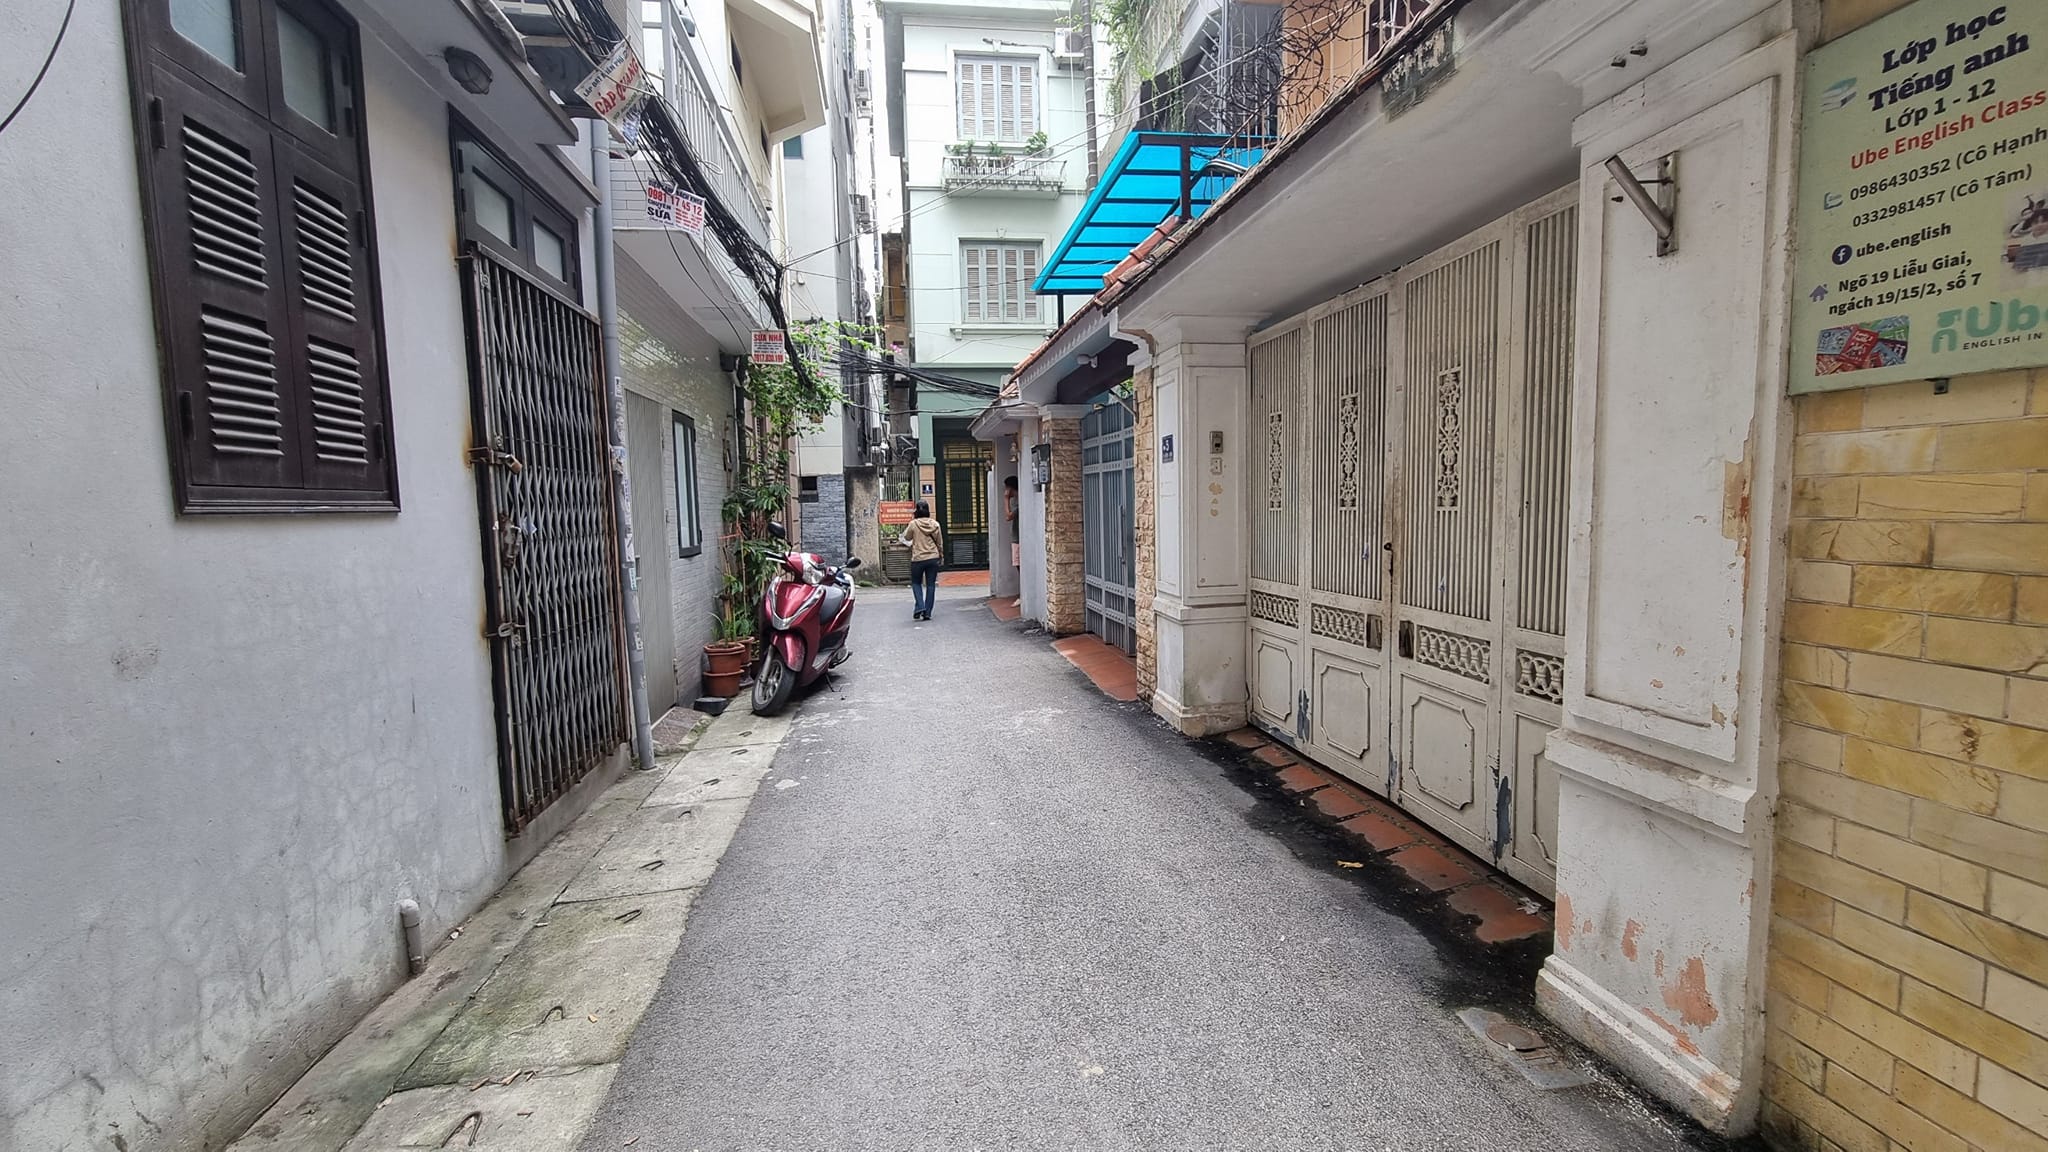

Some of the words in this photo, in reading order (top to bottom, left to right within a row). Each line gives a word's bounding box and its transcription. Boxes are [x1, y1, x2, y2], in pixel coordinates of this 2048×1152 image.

[1882, 40, 1936, 73] Lớp
[1945, 6, 2006, 46] học
[1868, 64, 1955, 111] Tiếng
[1963, 32, 2029, 74] anh
[1851, 147, 1889, 169] Ube
[1895, 114, 1975, 149] English
[1981, 90, 2047, 128] Class
[1885, 107, 1928, 133] Lớp
[1934, 98, 1946, 115] 1
[1967, 78, 1996, 103] 12
[1850, 159, 1951, 200] 0986430352
[1956, 145, 1987, 170] (Cô
[1853, 190, 1946, 227] 0332981457
[1951, 180, 1979, 202] (Cô
[1984, 163, 2032, 189] Tâm)
[671, 195, 680, 207] 17
[693, 204, 702, 217] 12
[1856, 223, 1951, 257] ube.english
[1829, 296, 1873, 315] ngách
[1876, 282, 1942, 306] 19/15/2,
[1946, 269, 1967, 291] số
[1971, 272, 1981, 285] 7
[1839, 274, 1867, 292] Ngõ
[1871, 271, 1889, 285] 19
[1893, 258, 1927, 280] Liễu
[1932, 251, 1972, 270] Giai,
[1963, 335, 2020, 350] ENGLISH
[2028, 332, 2042, 341] IN
[1966, 298, 2048, 338] Ub
